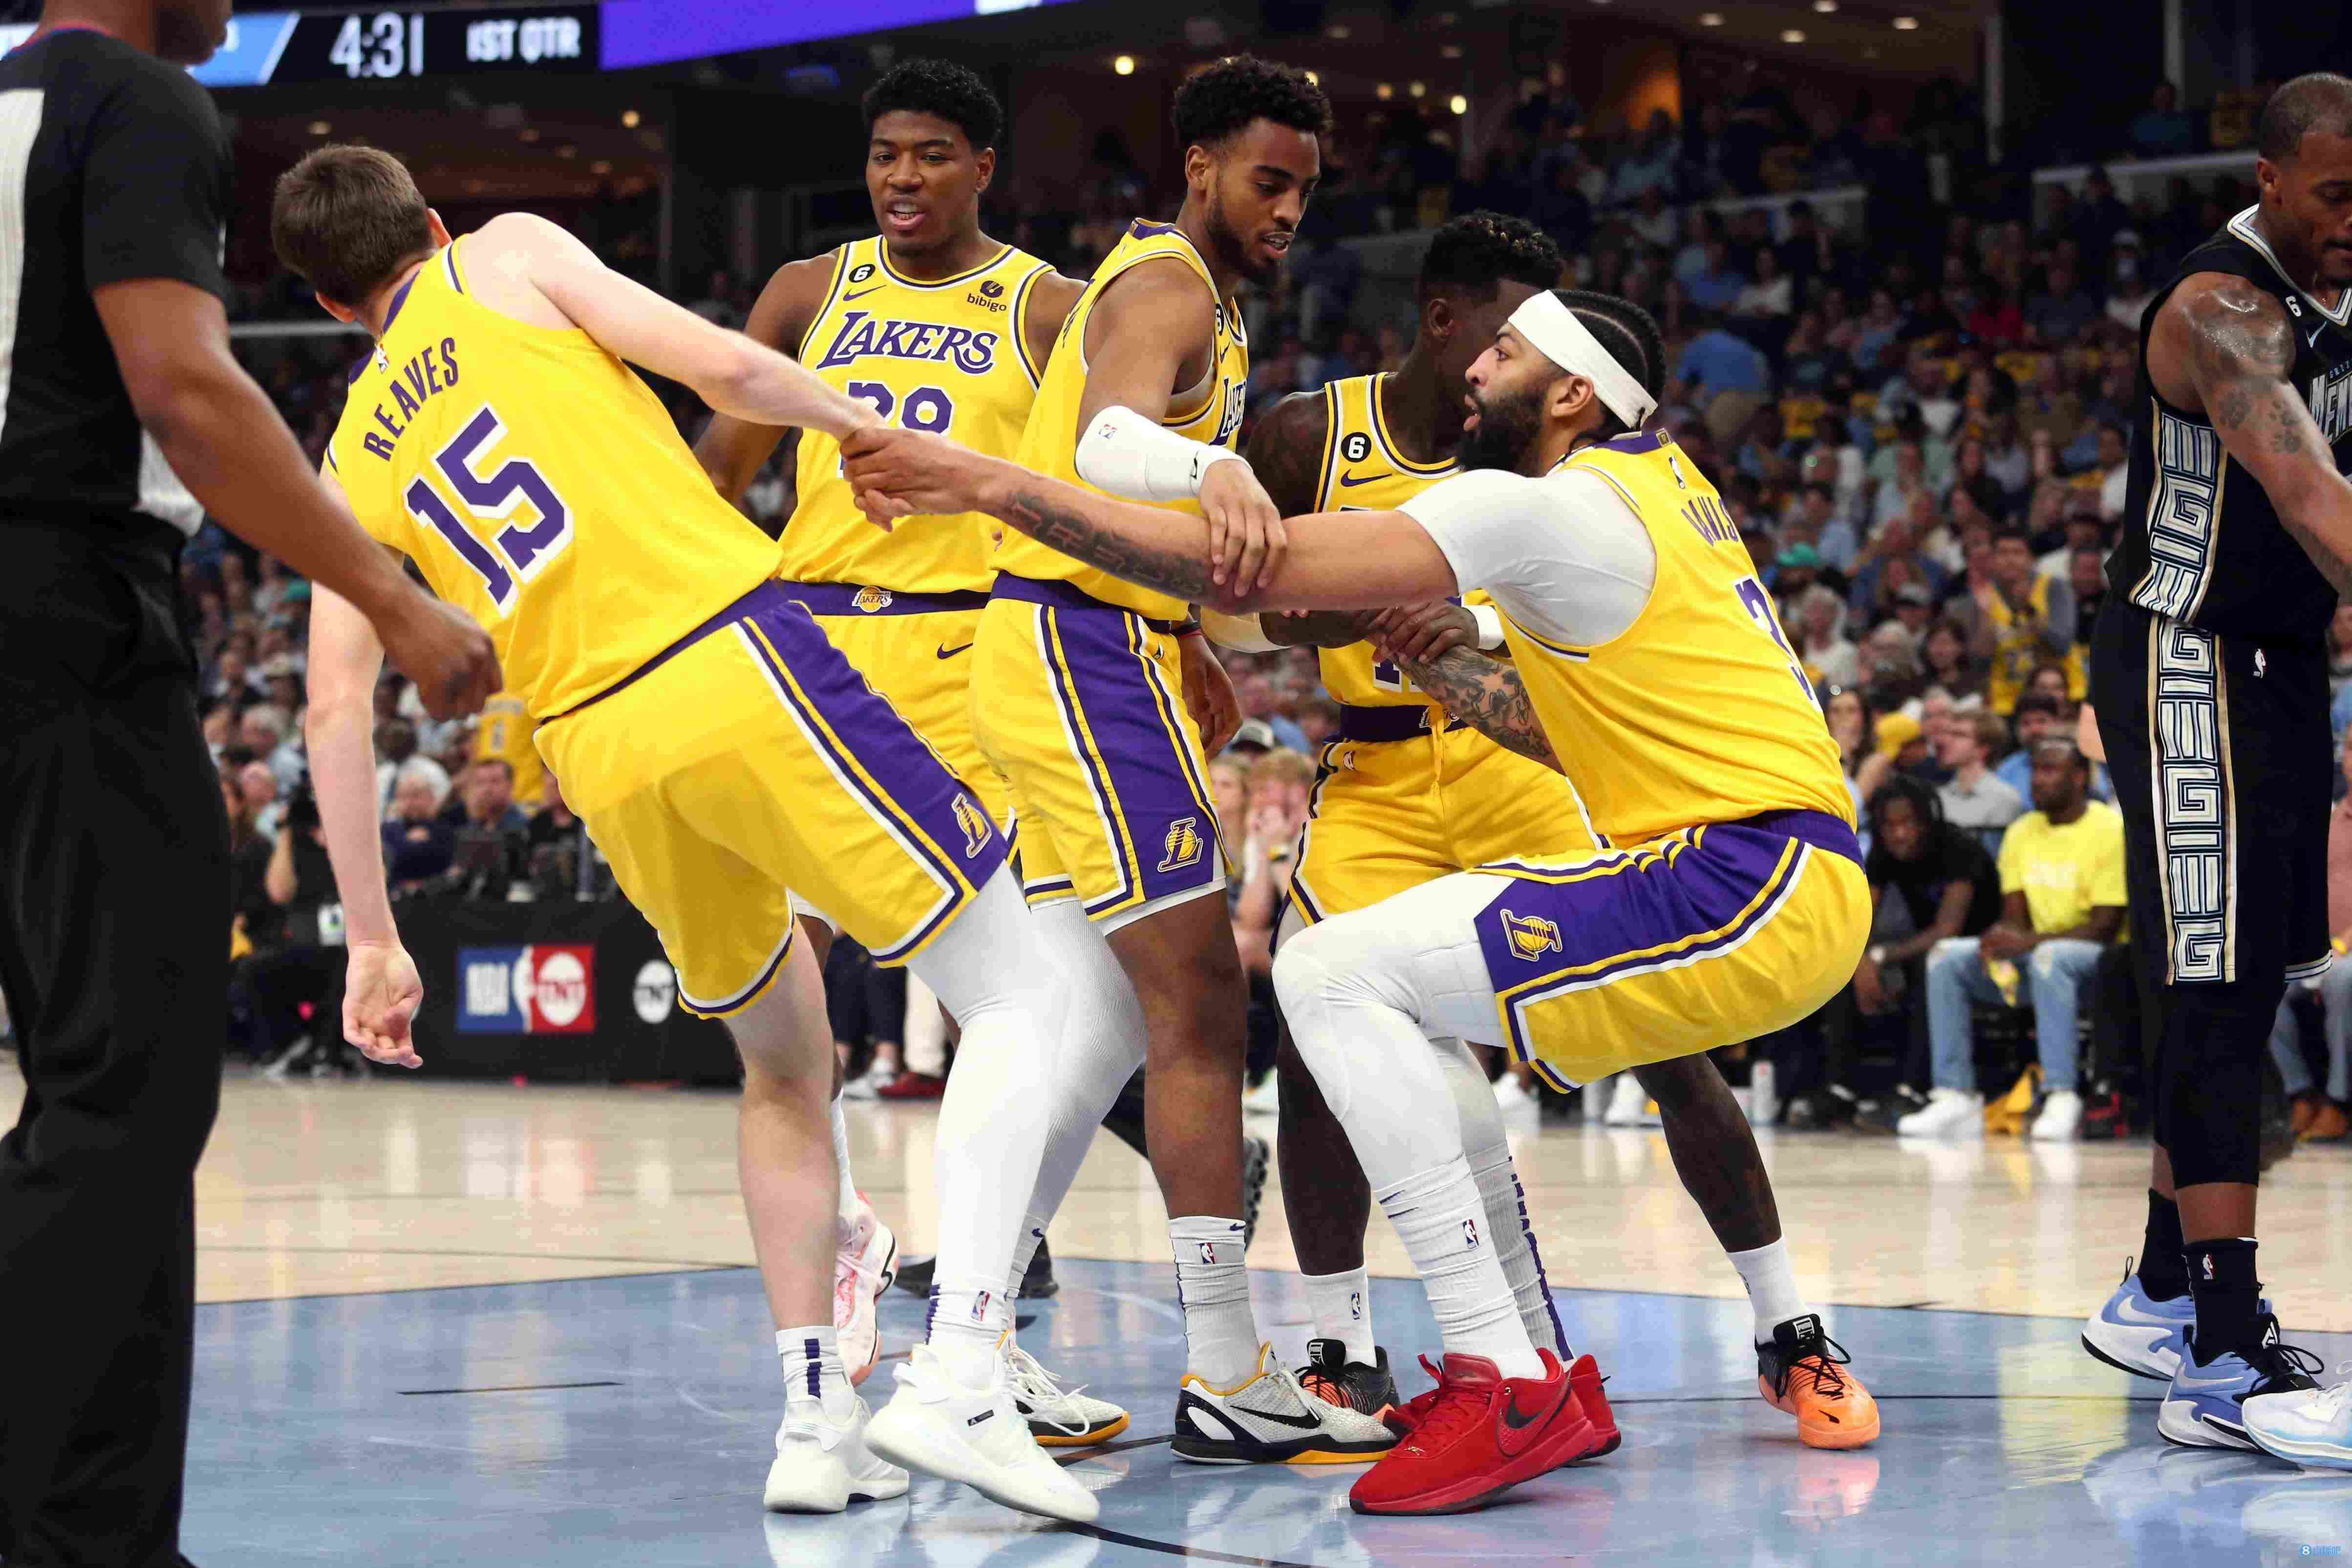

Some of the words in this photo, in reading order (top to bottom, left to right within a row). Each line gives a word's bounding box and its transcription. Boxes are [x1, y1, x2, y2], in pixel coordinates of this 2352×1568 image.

[330, 12, 424, 78] 4:31
[519, 17, 581, 64] QTR
[853, 266, 871, 281] 6
[967, 293, 1007, 312] bibigo
[2286, 296, 2302, 317] 6
[815, 311, 998, 375] LAKERS
[363, 337, 459, 462] REAVES
[1348, 436, 1365, 459] 6
[406, 405, 567, 609] 15
